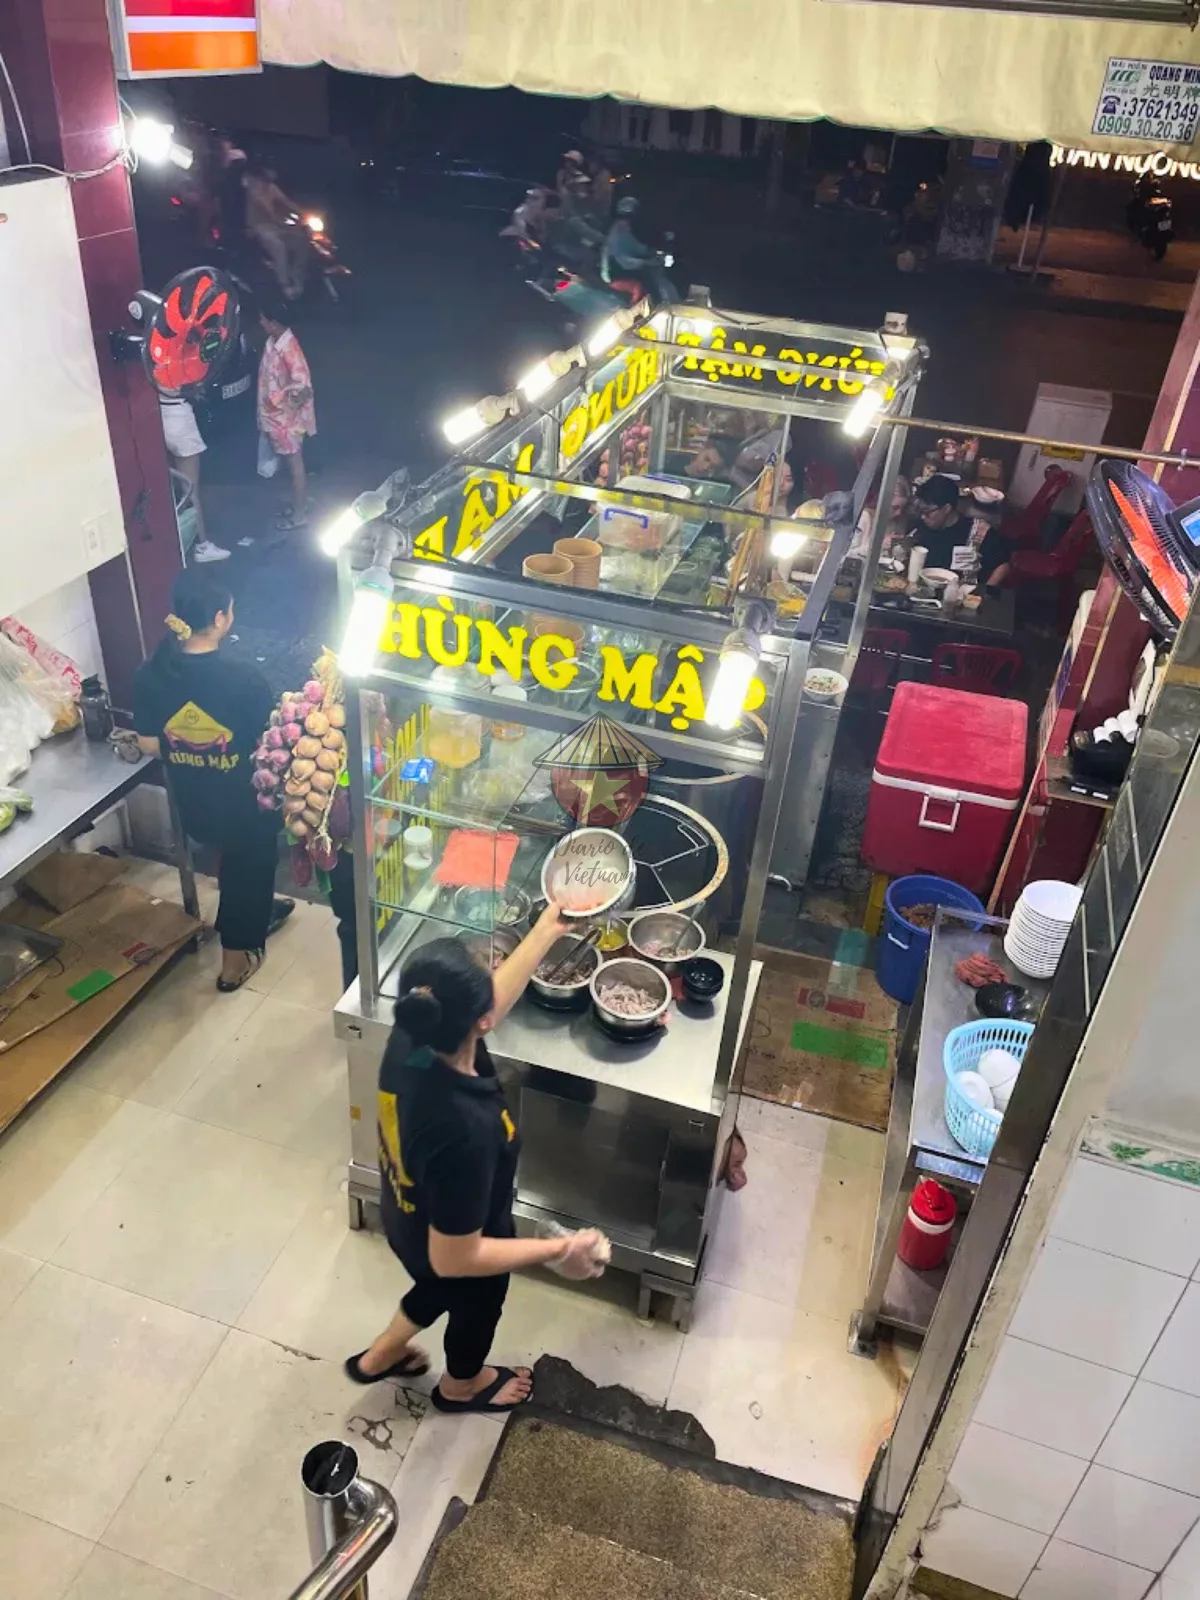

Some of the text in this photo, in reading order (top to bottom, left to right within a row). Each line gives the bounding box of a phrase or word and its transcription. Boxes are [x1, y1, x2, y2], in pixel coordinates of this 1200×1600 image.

[1149, 65, 1181, 82] QUANG
[1097, 115, 1193, 140] 0909.30.20.36
[378, 595, 579, 691] HÙNG
